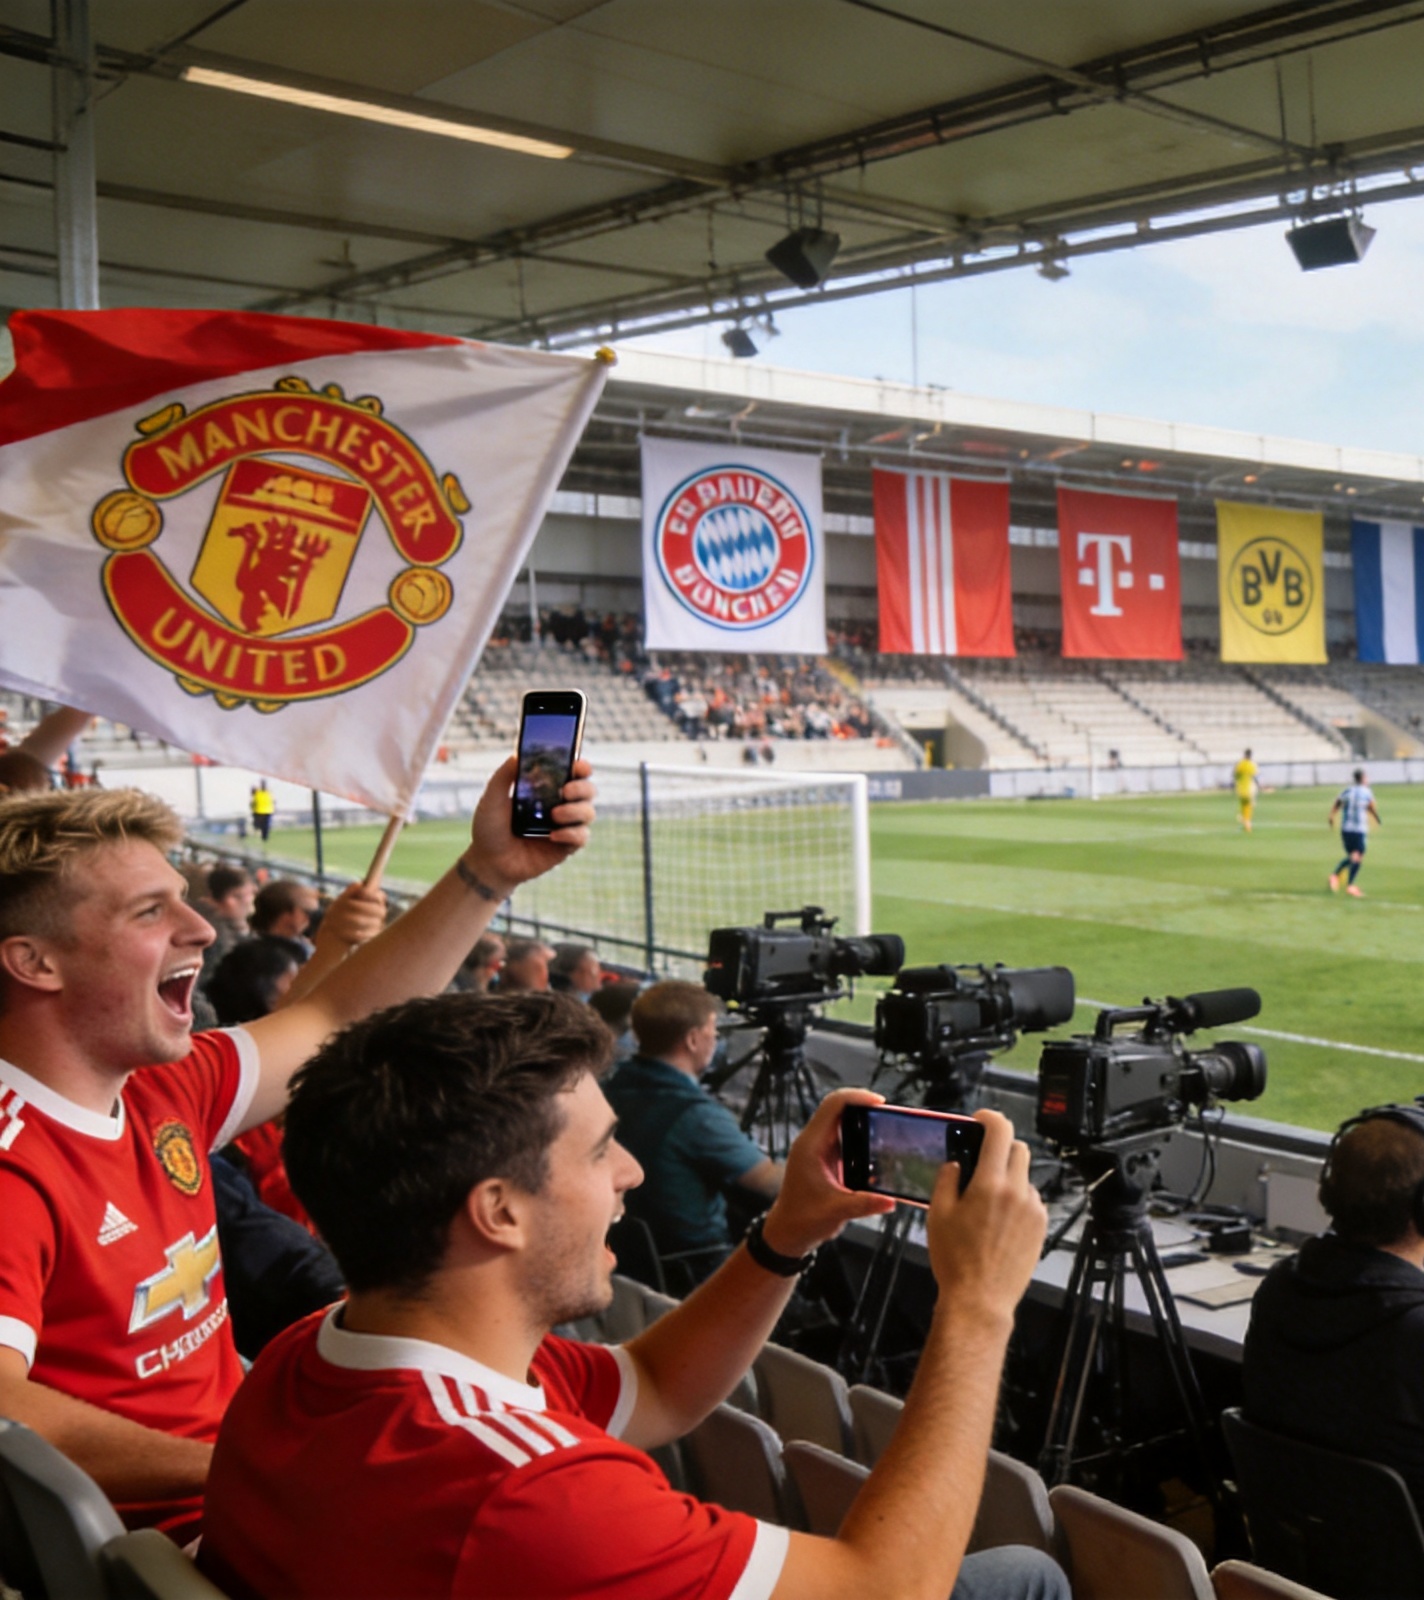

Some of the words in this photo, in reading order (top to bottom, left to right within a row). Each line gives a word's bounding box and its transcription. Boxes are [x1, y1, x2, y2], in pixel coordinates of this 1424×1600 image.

[156, 406, 437, 543] MANCHESTER
[1240, 549, 1305, 607] BVB
[151, 607, 347, 687] UNITED
